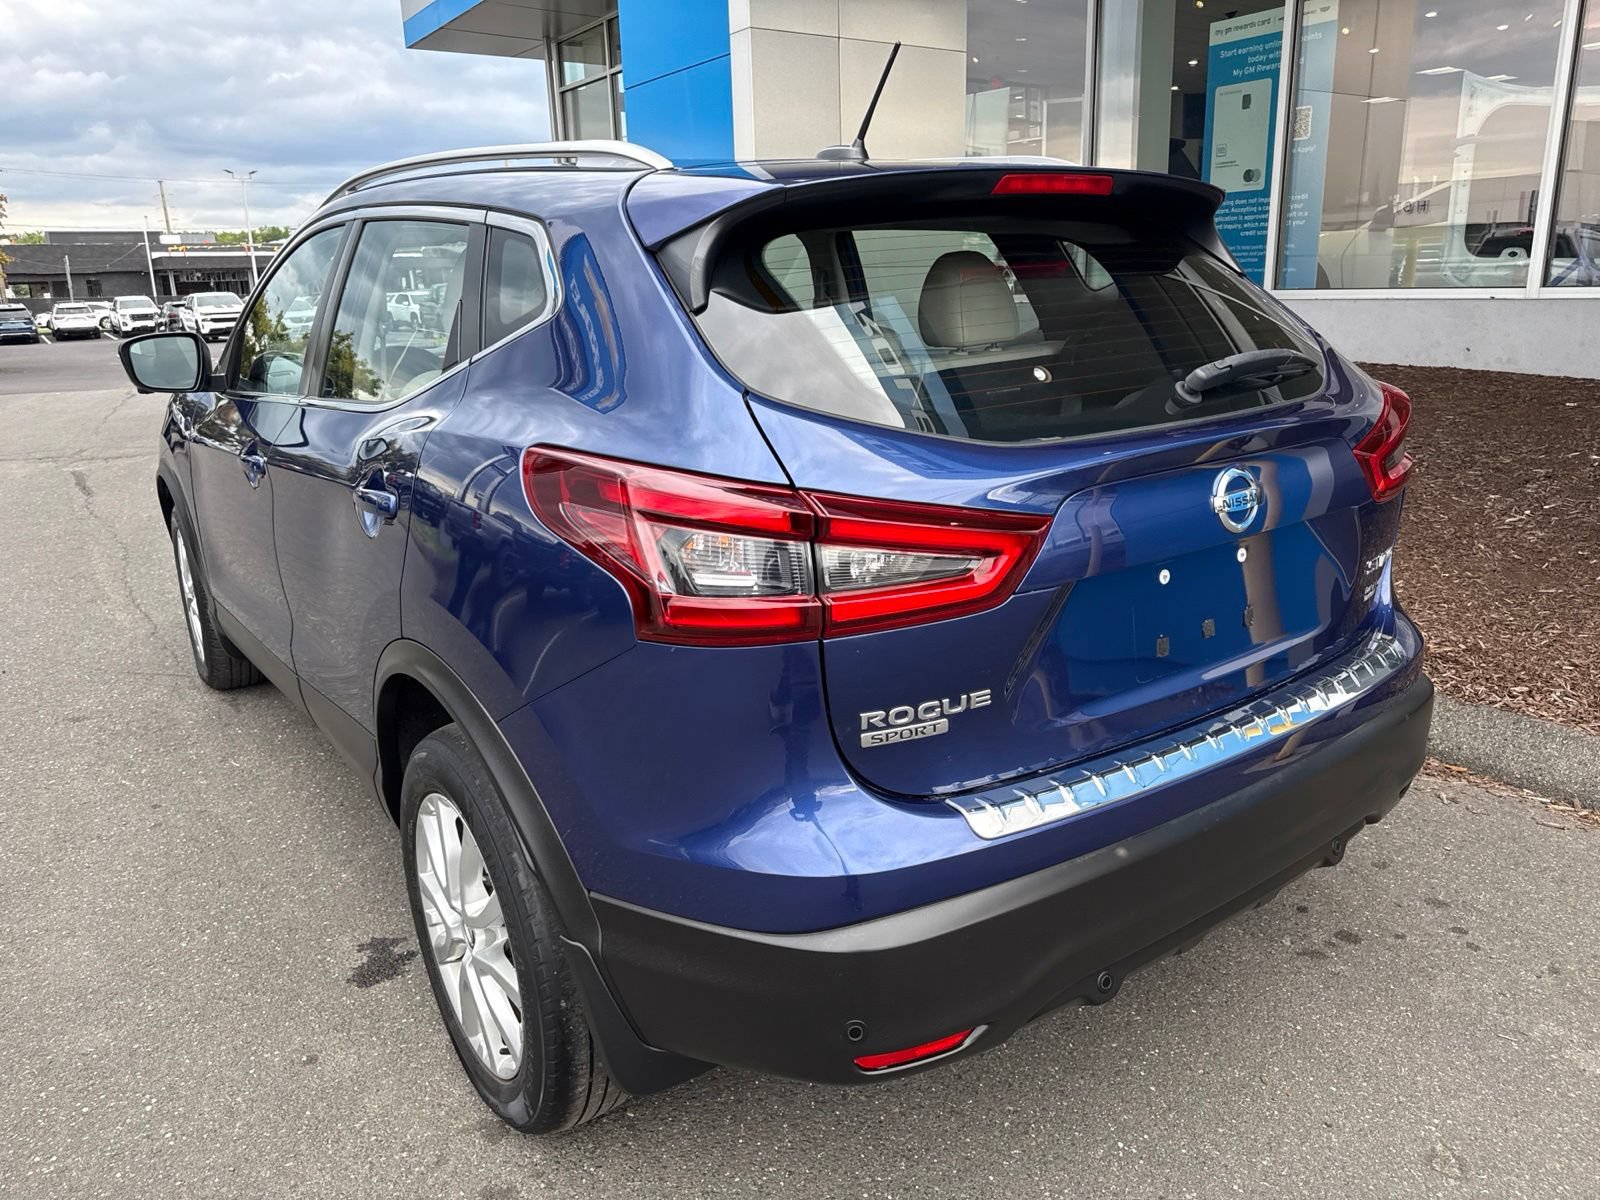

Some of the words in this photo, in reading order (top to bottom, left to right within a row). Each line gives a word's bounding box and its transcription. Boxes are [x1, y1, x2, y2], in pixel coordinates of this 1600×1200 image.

[1233, 21, 1256, 32] rewards
[1257, 18, 1271, 26] card
[1220, 48, 1238, 59] Start
[1237, 43, 1264, 55] earning
[1247, 54, 1267, 64] today
[1232, 68, 1243, 78] My
[1244, 65, 1255, 75] GM
[859, 689, 992, 731] ROGUE
[870, 722, 941, 745] SPORT
